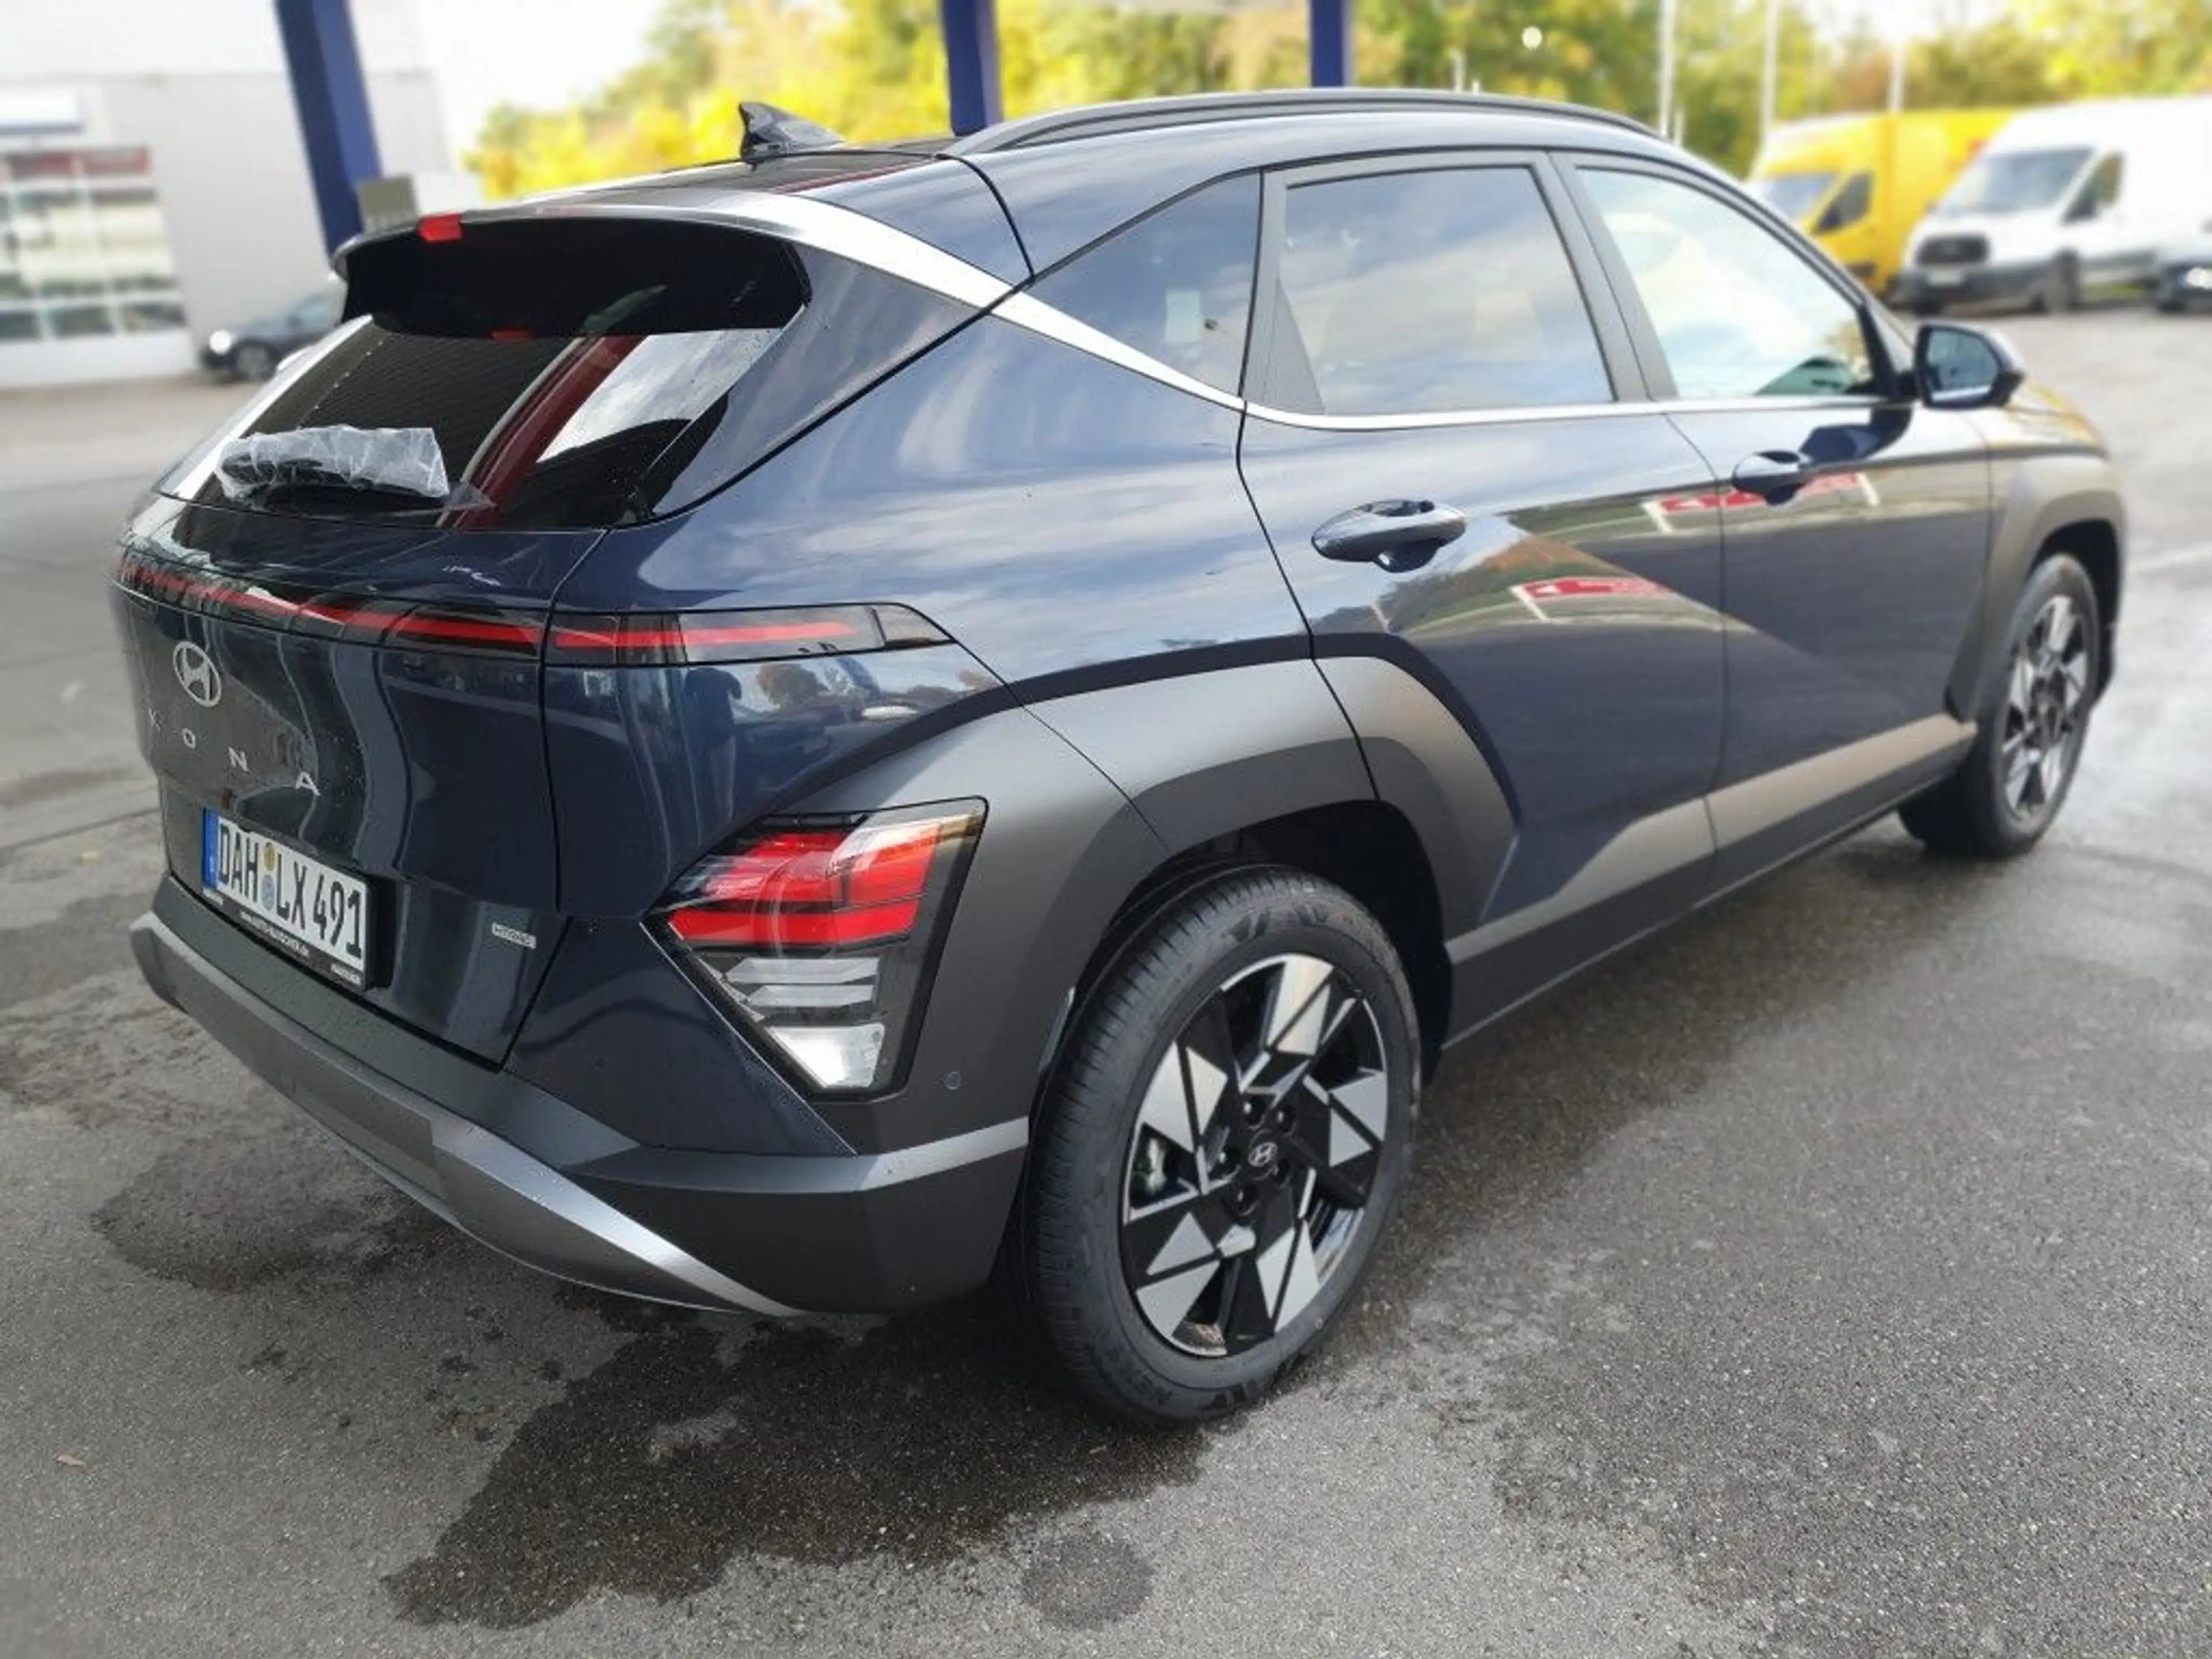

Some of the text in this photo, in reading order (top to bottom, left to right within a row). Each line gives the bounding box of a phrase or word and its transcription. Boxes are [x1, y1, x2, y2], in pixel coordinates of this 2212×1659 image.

[148, 707, 321, 796] KONA
[218, 823, 259, 903] DAH
[276, 851, 309, 930] LX
[312, 874, 362, 960] 491
